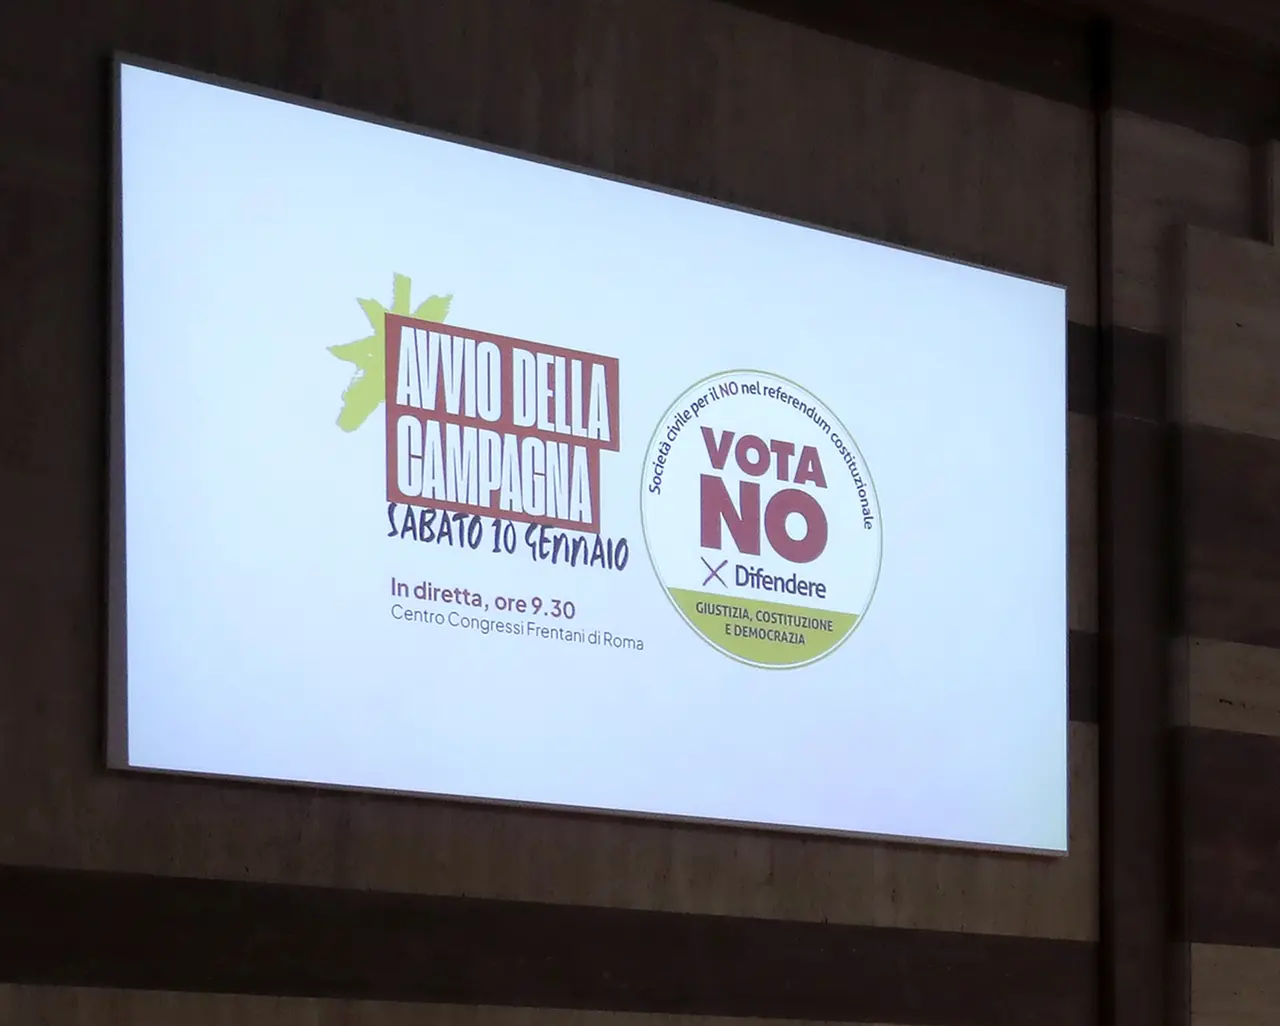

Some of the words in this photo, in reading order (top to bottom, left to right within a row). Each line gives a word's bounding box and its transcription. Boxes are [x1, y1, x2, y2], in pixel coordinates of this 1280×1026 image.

[396, 326, 501, 422] AVVIO
[512, 347, 610, 441] DELLA
[397, 415, 592, 524] CAMPAGNA
[649, 441, 671, 495] Società
[667, 410, 692, 441] civile
[690, 395, 709, 417] per
[709, 386, 720, 401] il
[719, 381, 738, 398] NO
[741, 381, 761, 395] nel
[763, 386, 831, 434] referendum
[830, 433, 874, 530] costituzionale
[700, 425, 828, 488] VOTA
[387, 502, 482, 550] SABATO
[492, 518, 517, 554] 10
[700, 473, 827, 564] NO
[391, 577, 409, 598] In
[414, 582, 489, 611] diretta,
[495, 597, 527, 613] ore
[531, 596, 575, 620] 9.30
[735, 564, 826, 598] Difendere
[391, 604, 444, 625] Centro
[448, 612, 523, 635] Congressi
[527, 622, 585, 644] Frentani
[588, 631, 600, 645] di
[604, 633, 644, 650] Roma
[696, 602, 753, 621] GIUSTIZIA,
[756, 610, 833, 632] COSTITUZIONE
[725, 624, 732, 635] E
[735, 624, 805, 645] DEMOCRAZIA
